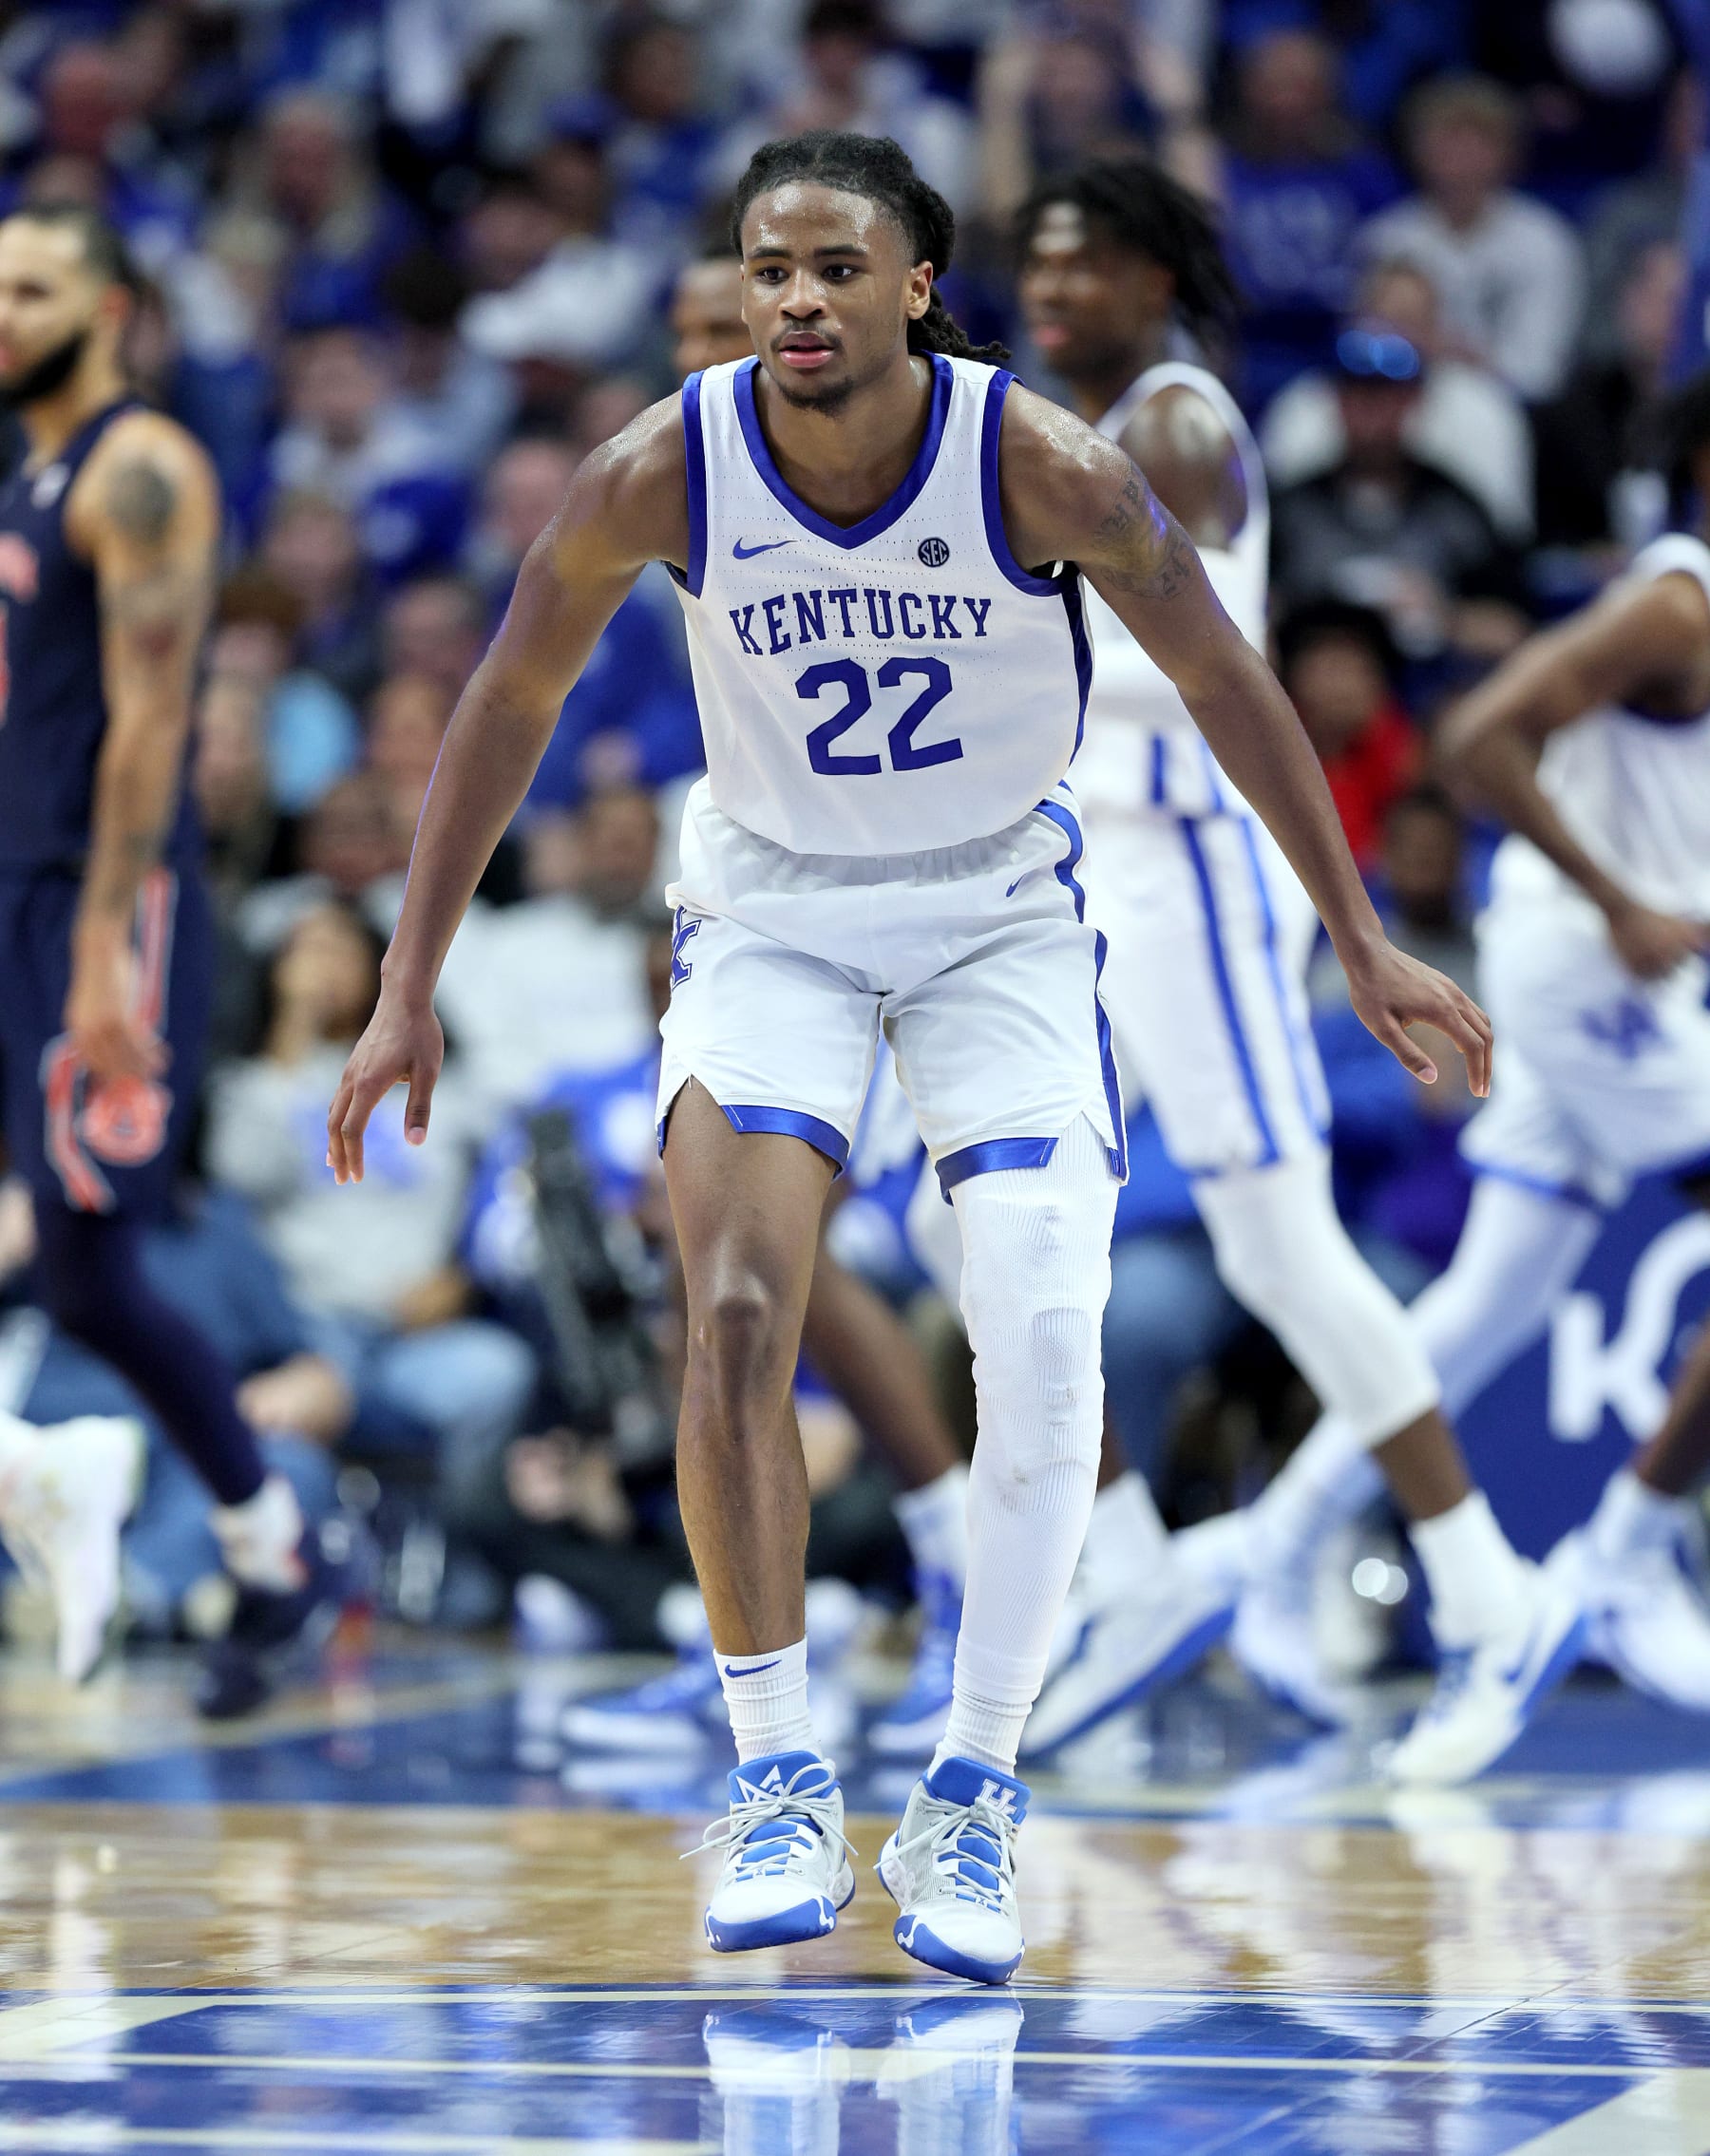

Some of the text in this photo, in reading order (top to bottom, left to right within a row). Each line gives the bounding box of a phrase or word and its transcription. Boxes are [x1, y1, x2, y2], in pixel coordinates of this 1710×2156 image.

[920, 539, 948, 566] SEC
[730, 589, 991, 655] KENTUCKY
[795, 657, 963, 775] 22
